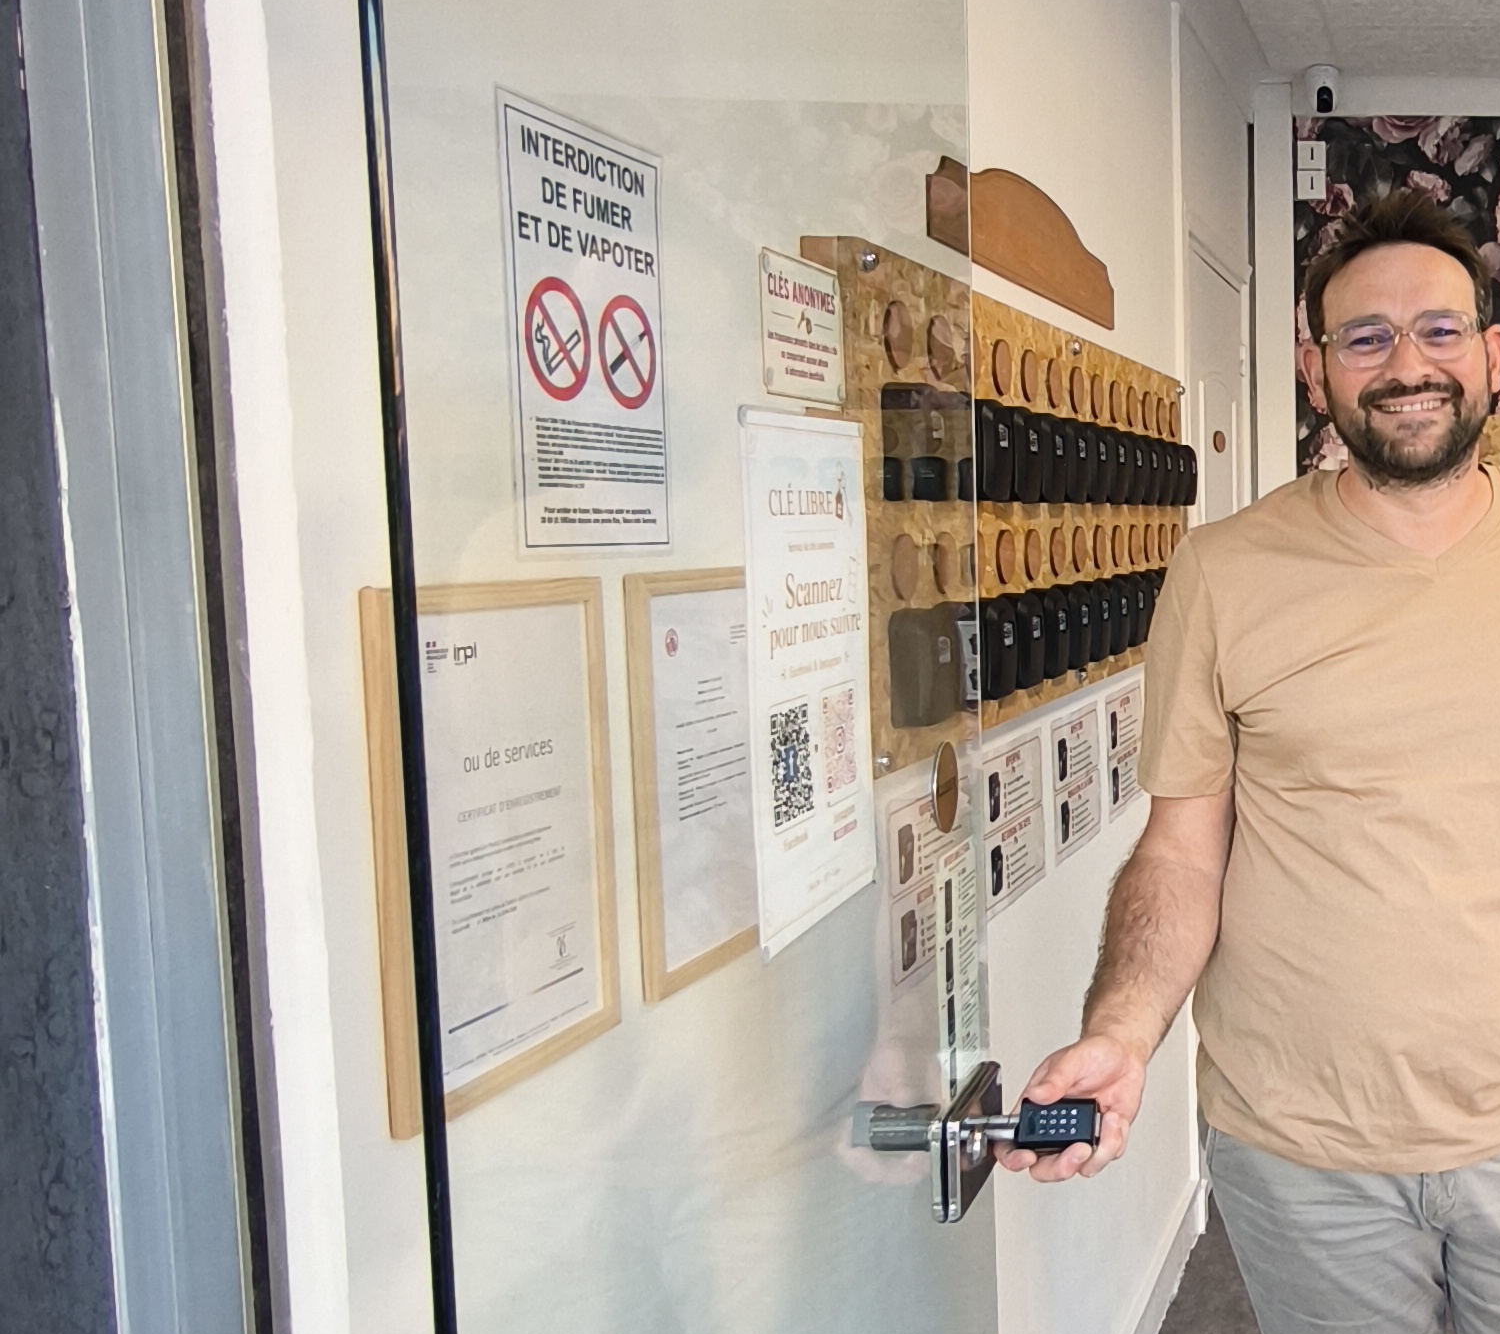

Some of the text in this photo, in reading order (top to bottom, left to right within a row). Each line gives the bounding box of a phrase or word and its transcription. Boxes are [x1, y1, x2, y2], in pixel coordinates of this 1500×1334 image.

[520, 124, 645, 198] INTERDICTION
[541, 176, 633, 232] DE FUMER
[517, 210, 656, 278] ET DE VAPOTER
[767, 270, 836, 315] CLÉS ANONYMES
[768, 482, 834, 517] CLÉ LIBRE
[785, 572, 843, 610] Scannez
[769, 623, 799, 660] pour
[801, 616, 829, 643] nous
[830, 611, 861, 637] suivre
[463, 738, 554, 773] ou de services
